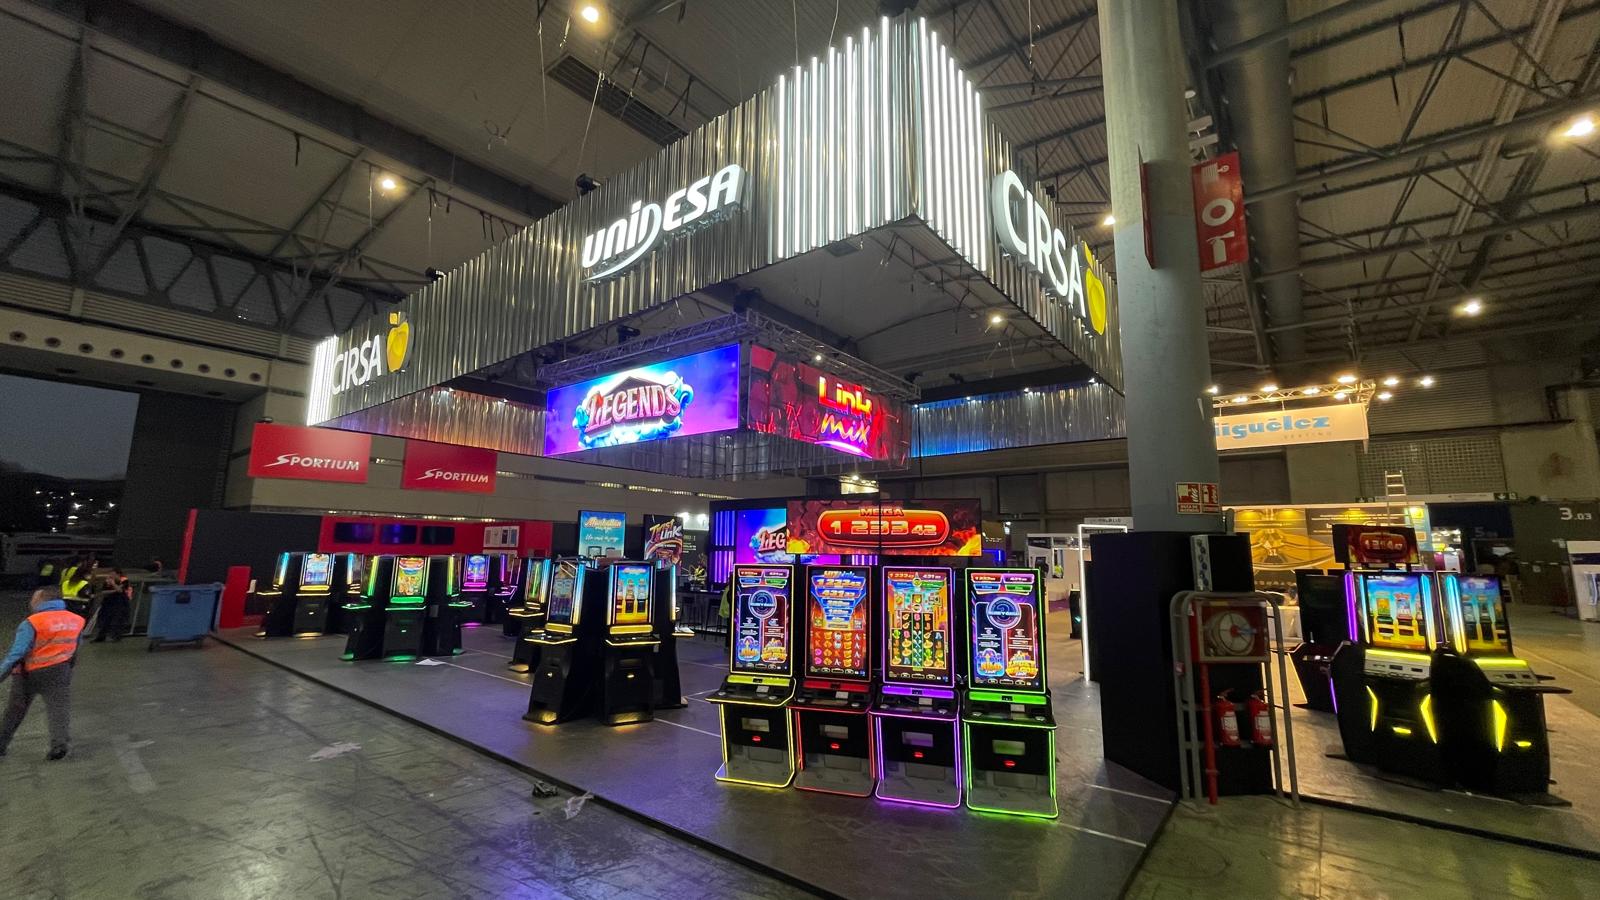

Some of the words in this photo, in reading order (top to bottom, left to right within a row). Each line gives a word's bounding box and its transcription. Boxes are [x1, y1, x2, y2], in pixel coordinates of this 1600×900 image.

[991, 169, 1087, 319] CIRSA
[331, 334, 382, 395] CIRSA
[584, 384, 681, 433] LEGENDS
[264, 453, 360, 471] SPORTIUM
[416, 467, 489, 484] SPORTIUM
[859, 508, 904, 517] MEGA
